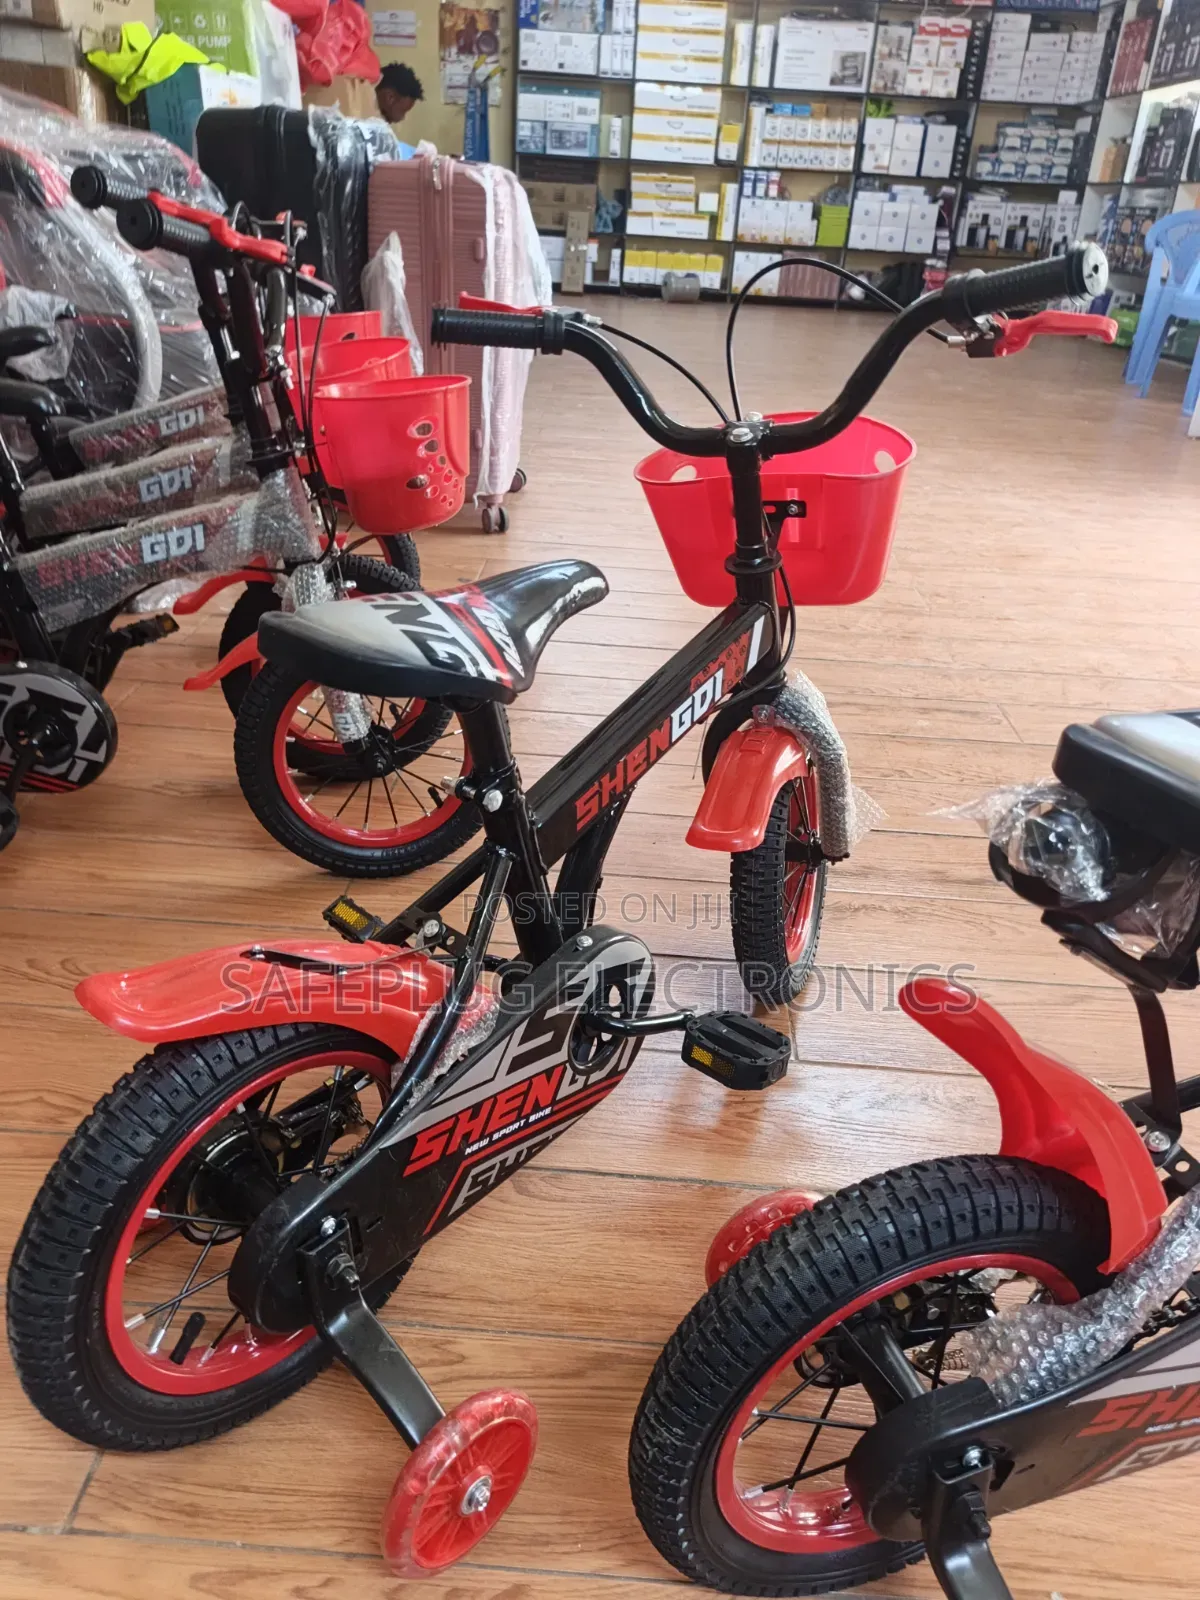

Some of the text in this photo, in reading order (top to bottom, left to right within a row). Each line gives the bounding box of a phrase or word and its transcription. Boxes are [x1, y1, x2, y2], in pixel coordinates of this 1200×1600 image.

[197, 35, 232, 48] PUMP
[464, 1106, 552, 1156] NEW SPORT BIKE
